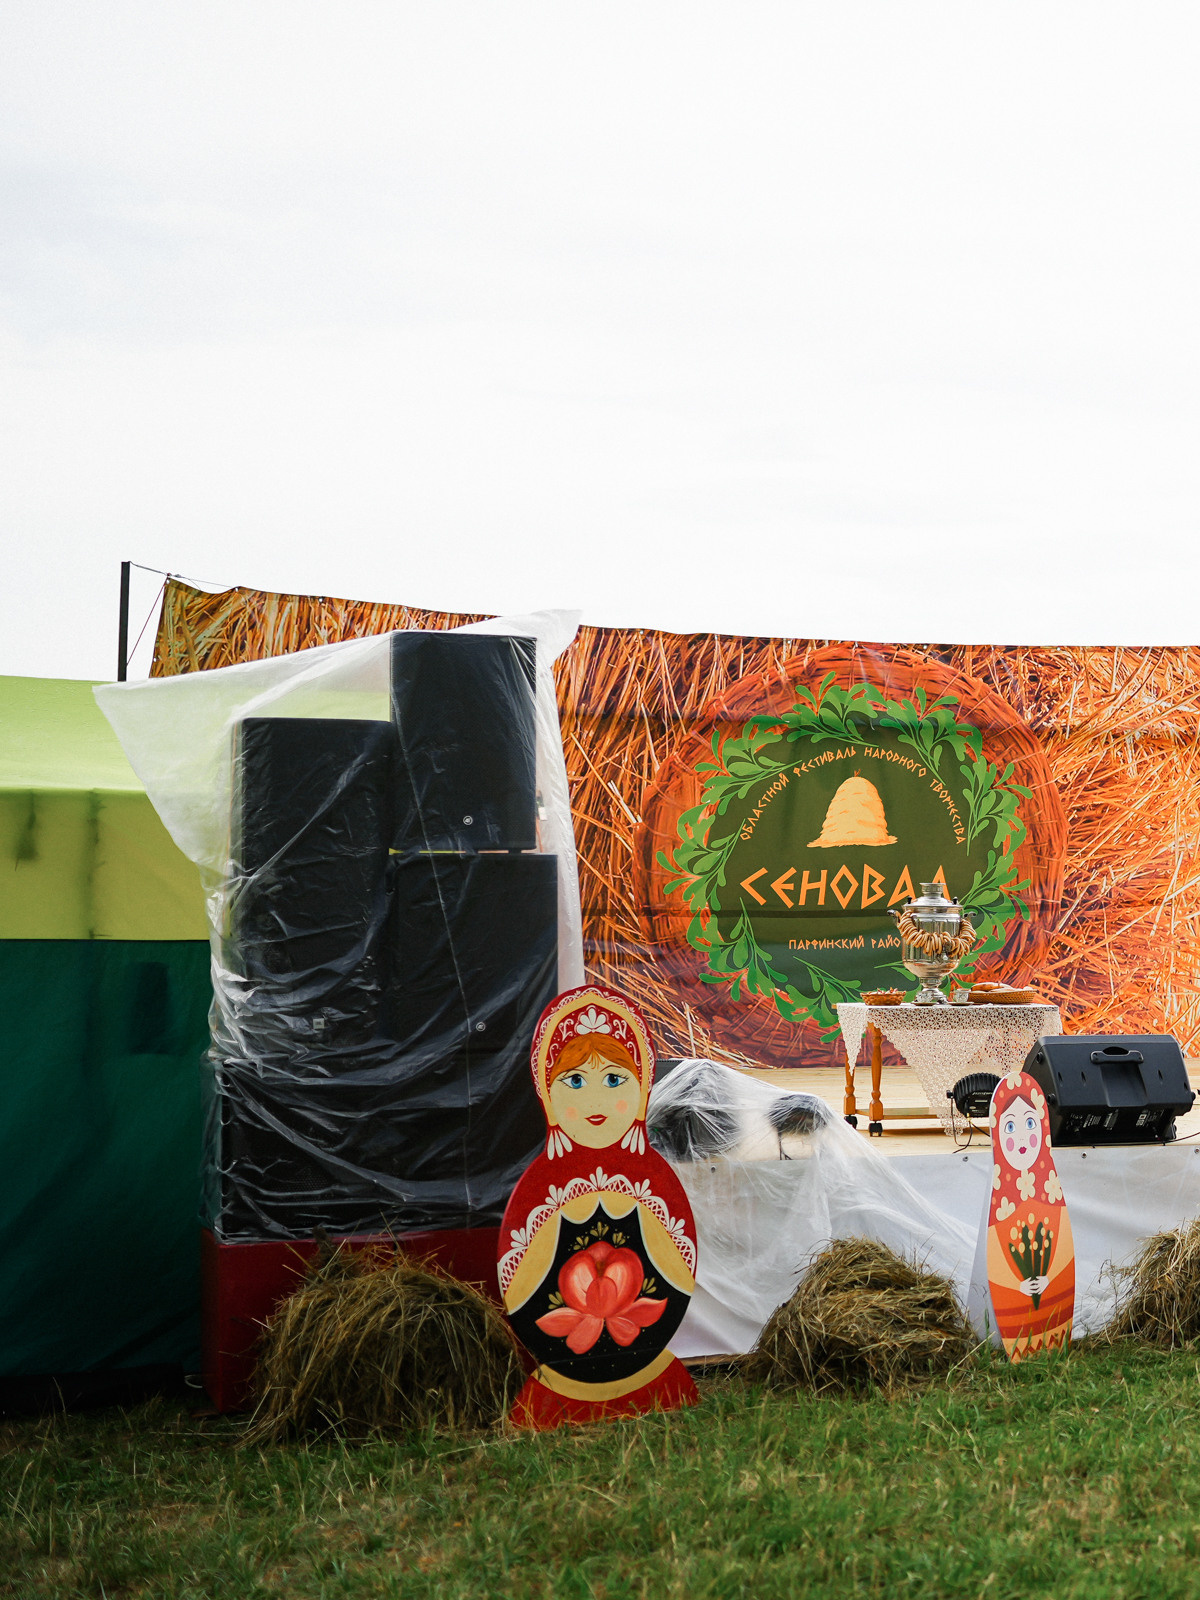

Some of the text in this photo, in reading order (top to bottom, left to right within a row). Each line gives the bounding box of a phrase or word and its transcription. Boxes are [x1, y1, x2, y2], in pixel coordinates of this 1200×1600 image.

[739, 746, 967, 845] ОБЛАСТНОЙ ФЕСТИВАЛЬ НАРОДНОГО ТВОРЧЕСТВА
[788, 934, 902, 950] ПАРФИНСКИЙ РАЙО
